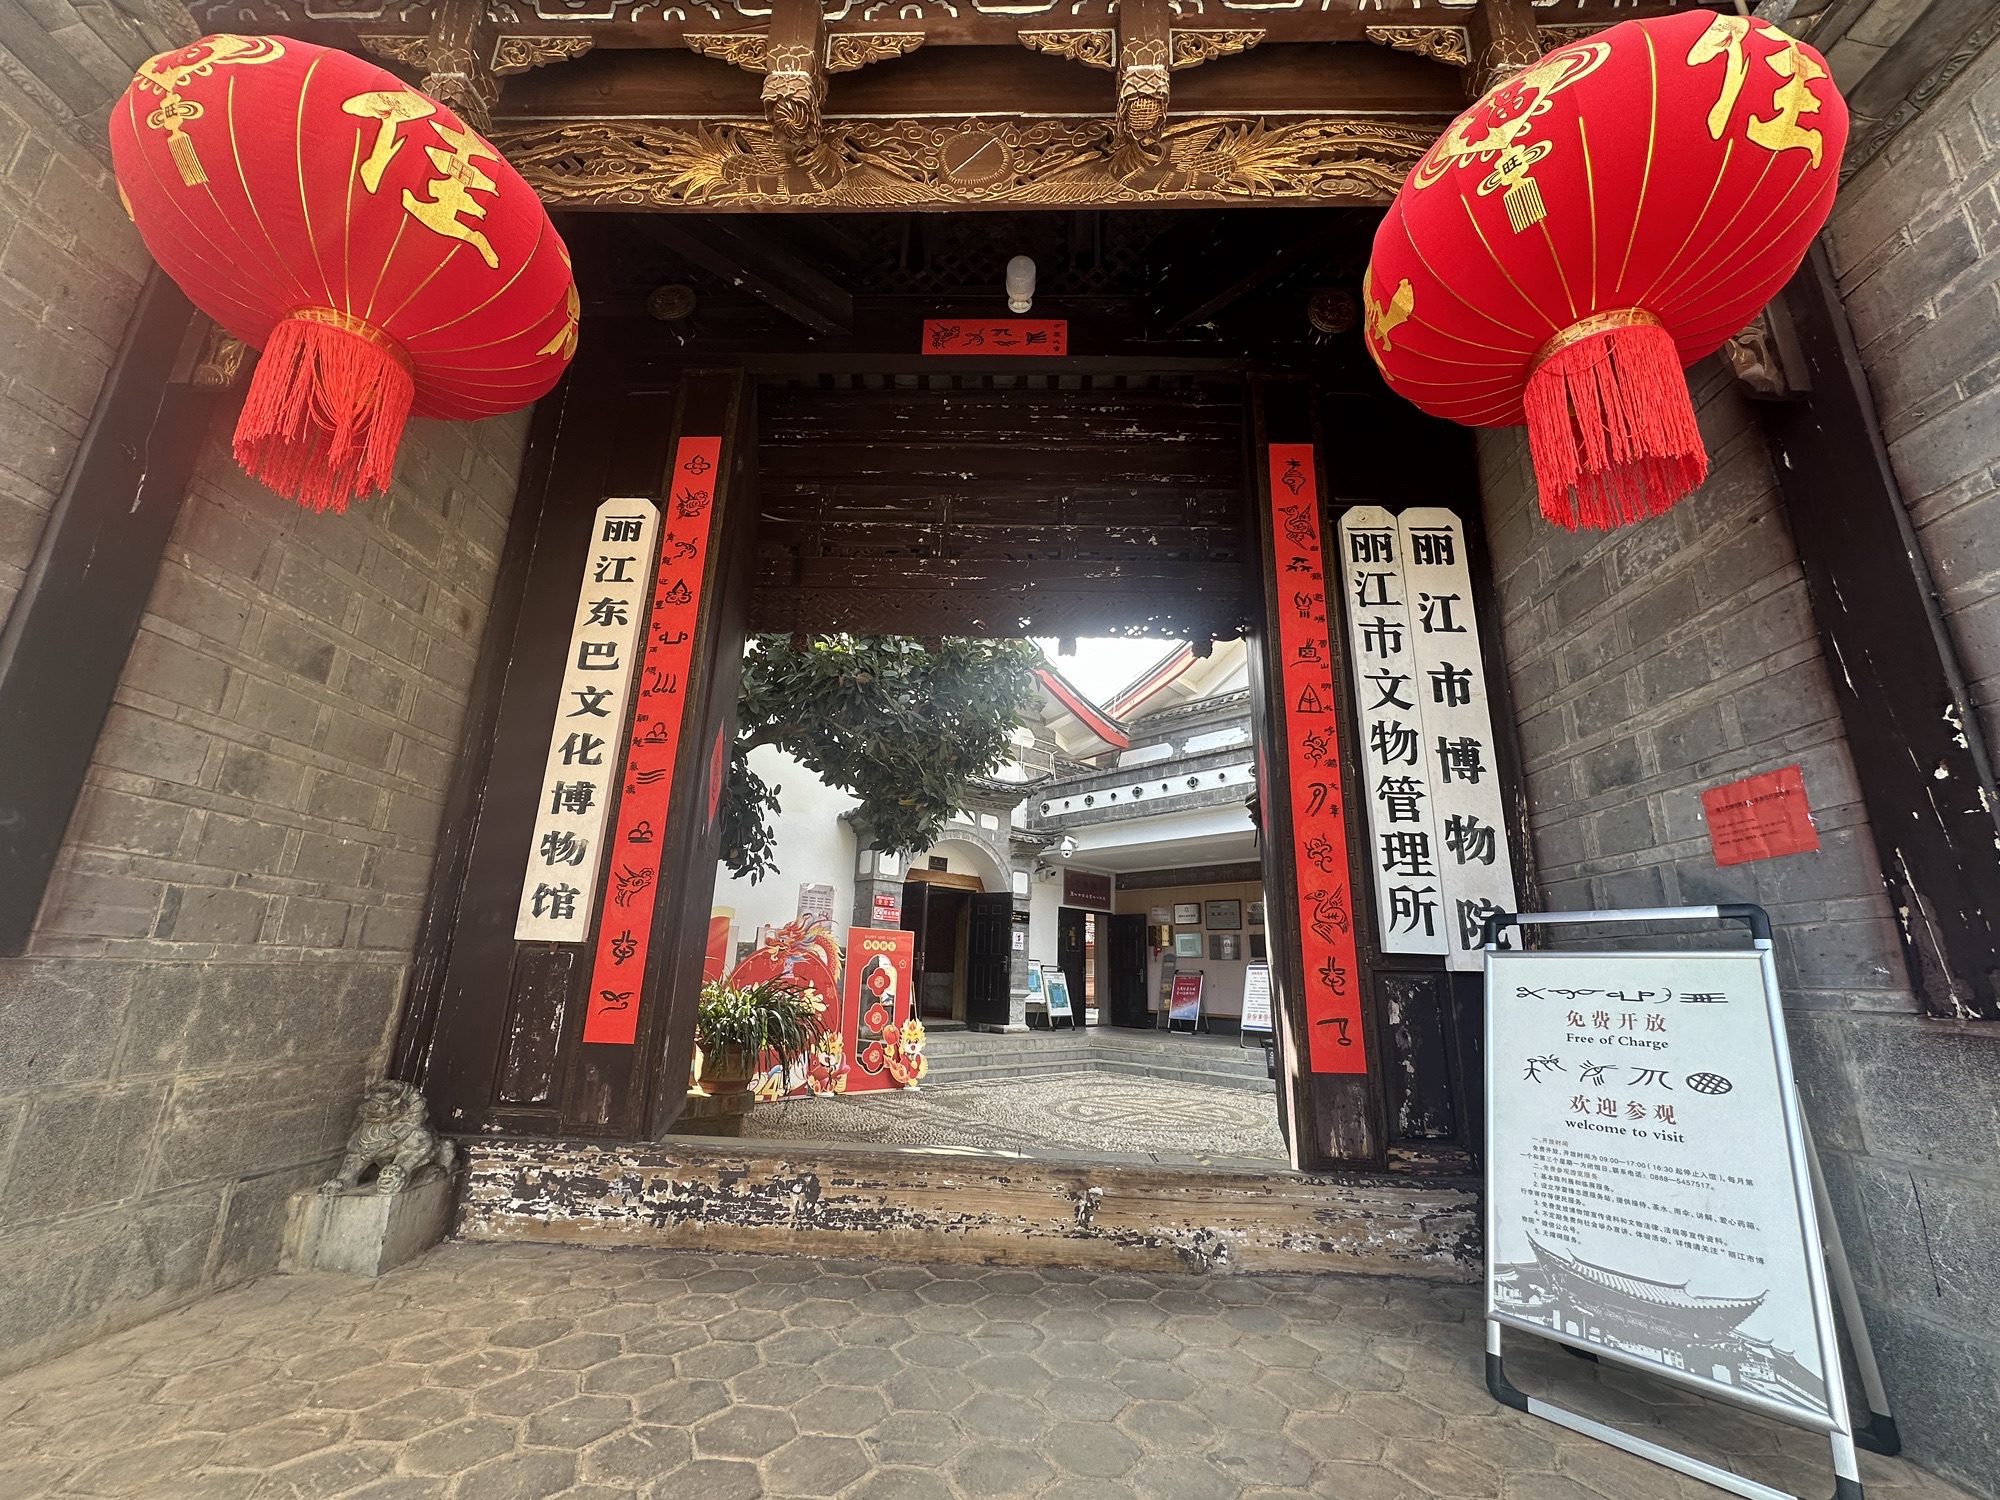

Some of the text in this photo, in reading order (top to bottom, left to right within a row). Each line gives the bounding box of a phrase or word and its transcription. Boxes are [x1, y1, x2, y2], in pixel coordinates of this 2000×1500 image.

[164, 102, 178, 118] 旺
[1502, 153, 1524, 176] 旺
[530, 513, 647, 920] 丽江东巴文化博物馆
[1345, 525, 1440, 938] 丽江市文物管理所
[1407, 524, 1513, 952] 丽江市博物院
[1565, 1009, 1668, 1033] 免费开放
[1566, 1032, 1669, 1051] Free of Charge
[1568, 1094, 1678, 1126] 欢迎参观
[1565, 1119, 1685, 1144] welcome to visit
